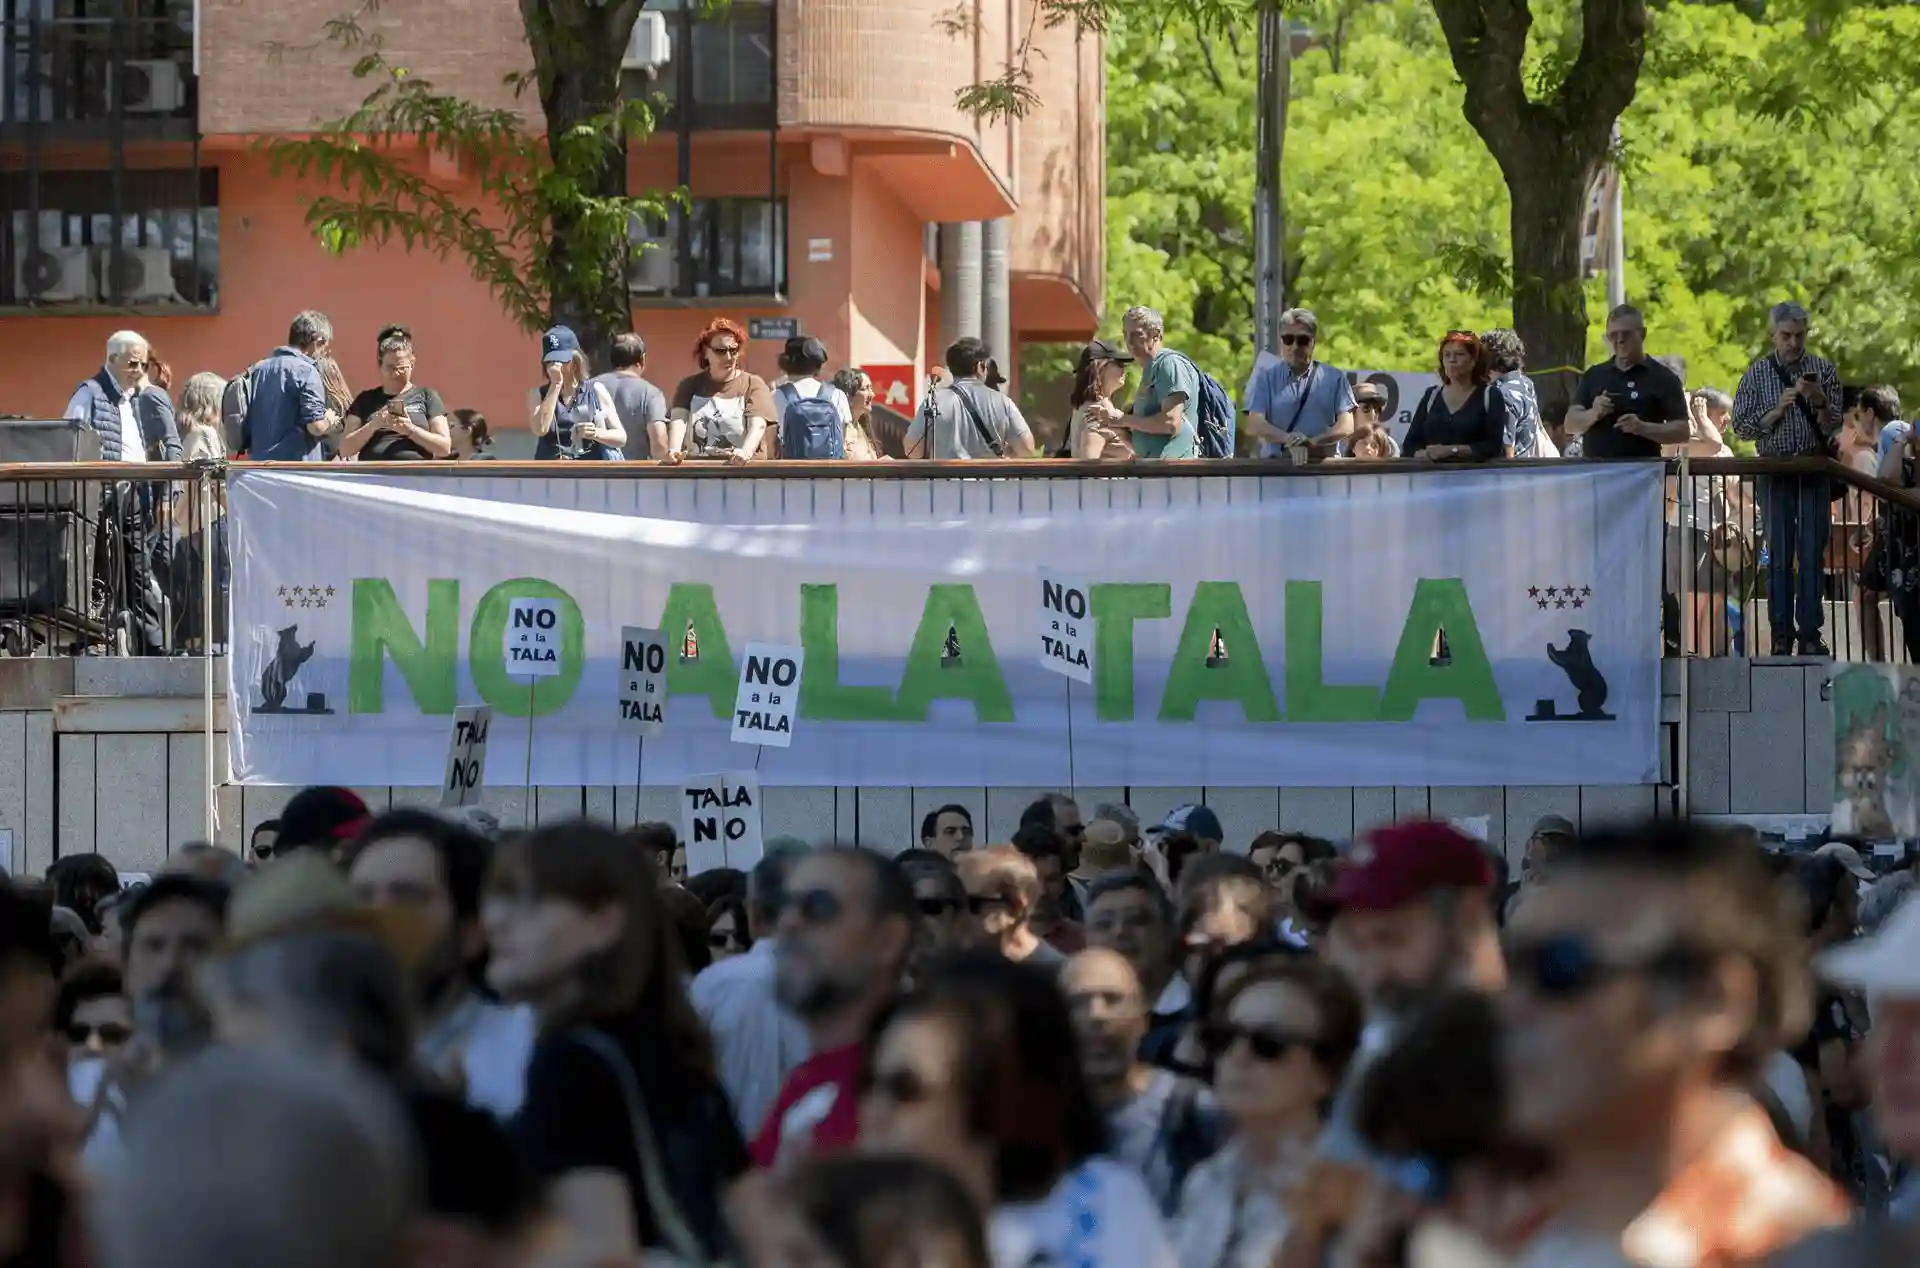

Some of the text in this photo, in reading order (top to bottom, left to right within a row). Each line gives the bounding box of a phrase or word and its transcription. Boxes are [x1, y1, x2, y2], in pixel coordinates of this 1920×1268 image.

[1347, 372, 1399, 422] O
[1042, 579, 1086, 620] NO
[513, 608, 556, 629] NO
[1051, 620, 1077, 638] a la
[350, 577, 1507, 722] NO A LA TALA
[520, 633, 546, 643] a la
[510, 647, 557, 662] TALA
[623, 640, 664, 674] NO
[1041, 635, 1090, 670] TALA
[745, 655, 797, 687] NO
[630, 680, 655, 694] a la
[751, 692, 781, 705] a la
[620, 699, 663, 723] TALA
[736, 710, 790, 734] TALA
[450, 758, 480, 791] NO
[685, 785, 752, 810] TALA
[693, 817, 746, 843] NO
